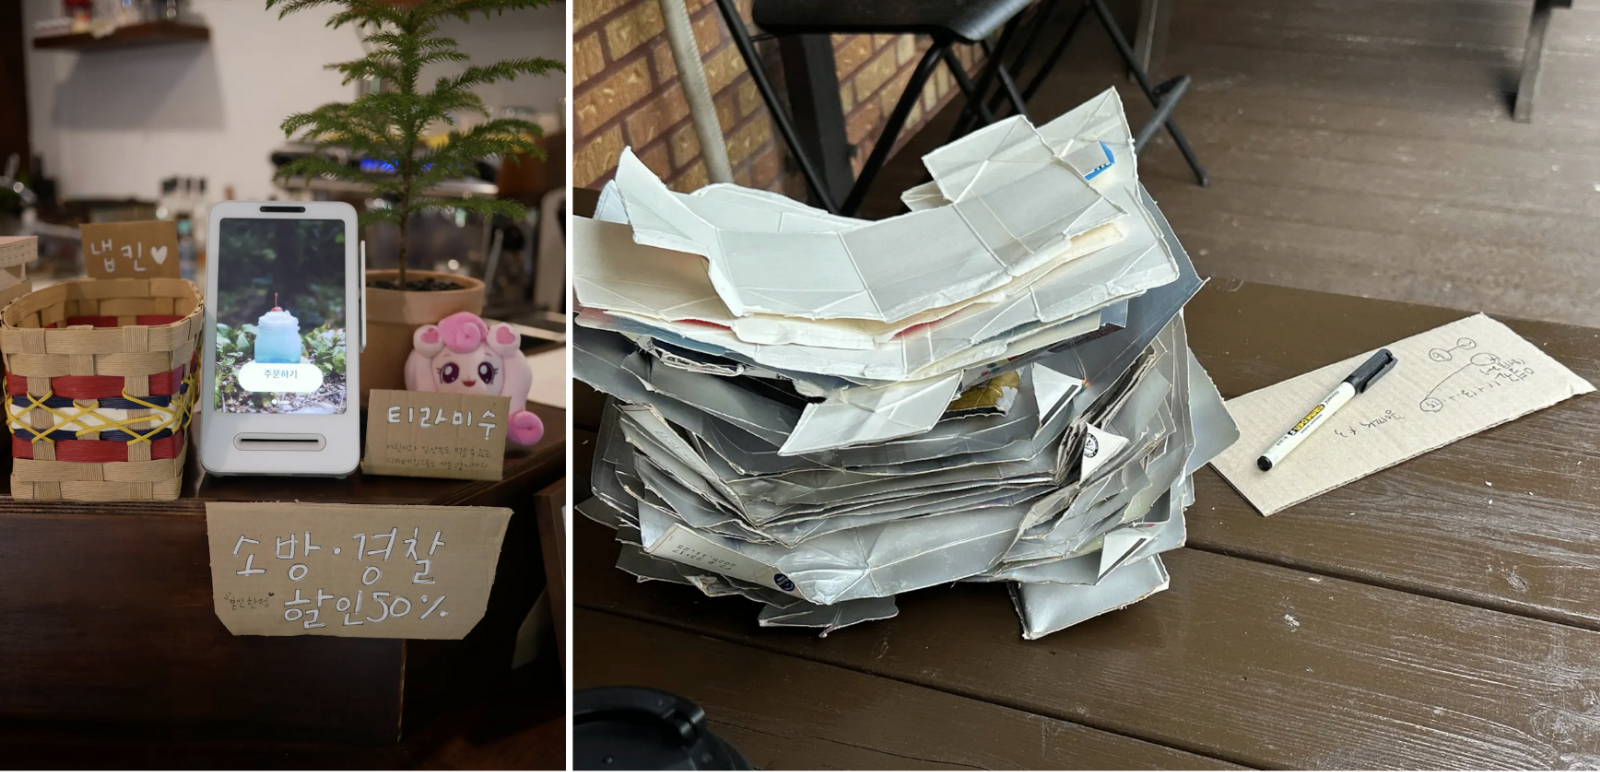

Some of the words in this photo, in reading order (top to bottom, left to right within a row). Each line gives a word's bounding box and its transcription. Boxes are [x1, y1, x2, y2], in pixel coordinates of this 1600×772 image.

[90, 237, 147, 273] 냅킨
[263, 369, 298, 379] 주문하기
[387, 405, 497, 440] 티라미수
